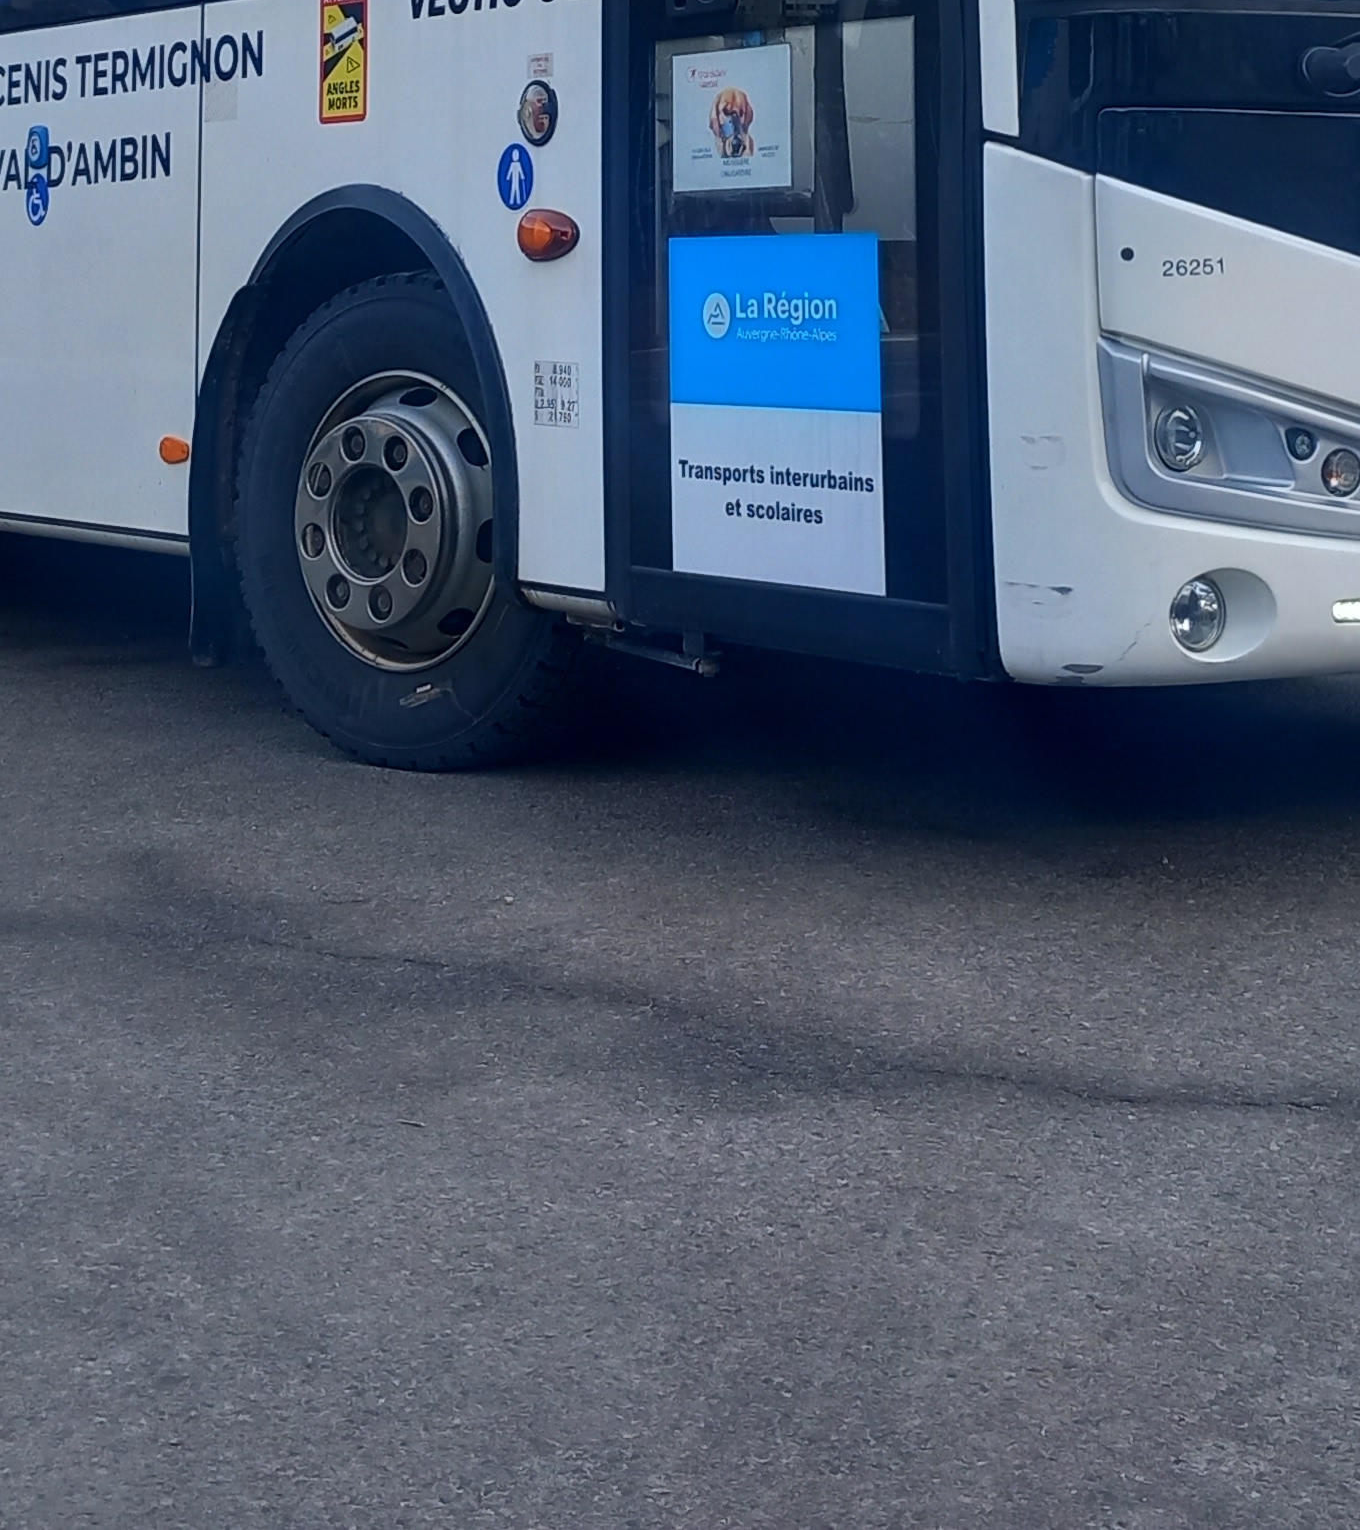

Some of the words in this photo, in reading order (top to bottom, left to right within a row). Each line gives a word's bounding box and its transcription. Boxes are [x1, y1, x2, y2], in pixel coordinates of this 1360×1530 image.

[76, 30, 265, 98] TERMIGNON
[326, 80, 360, 96] ANGLES
[328, 96, 358, 111] MORTS
[48, 131, 172, 188] D'AMBIN
[1161, 257, 1226, 277] 26251
[735, 293, 759, 320] La
[763, 291, 837, 324] Région
[736, 325, 838, 343] Auvergne-Rhône-Alpes
[678, 458, 765, 487] Transports
[770, 465, 874, 494] interurbains
[725, 500, 742, 519] et
[747, 501, 824, 526] scolaires
